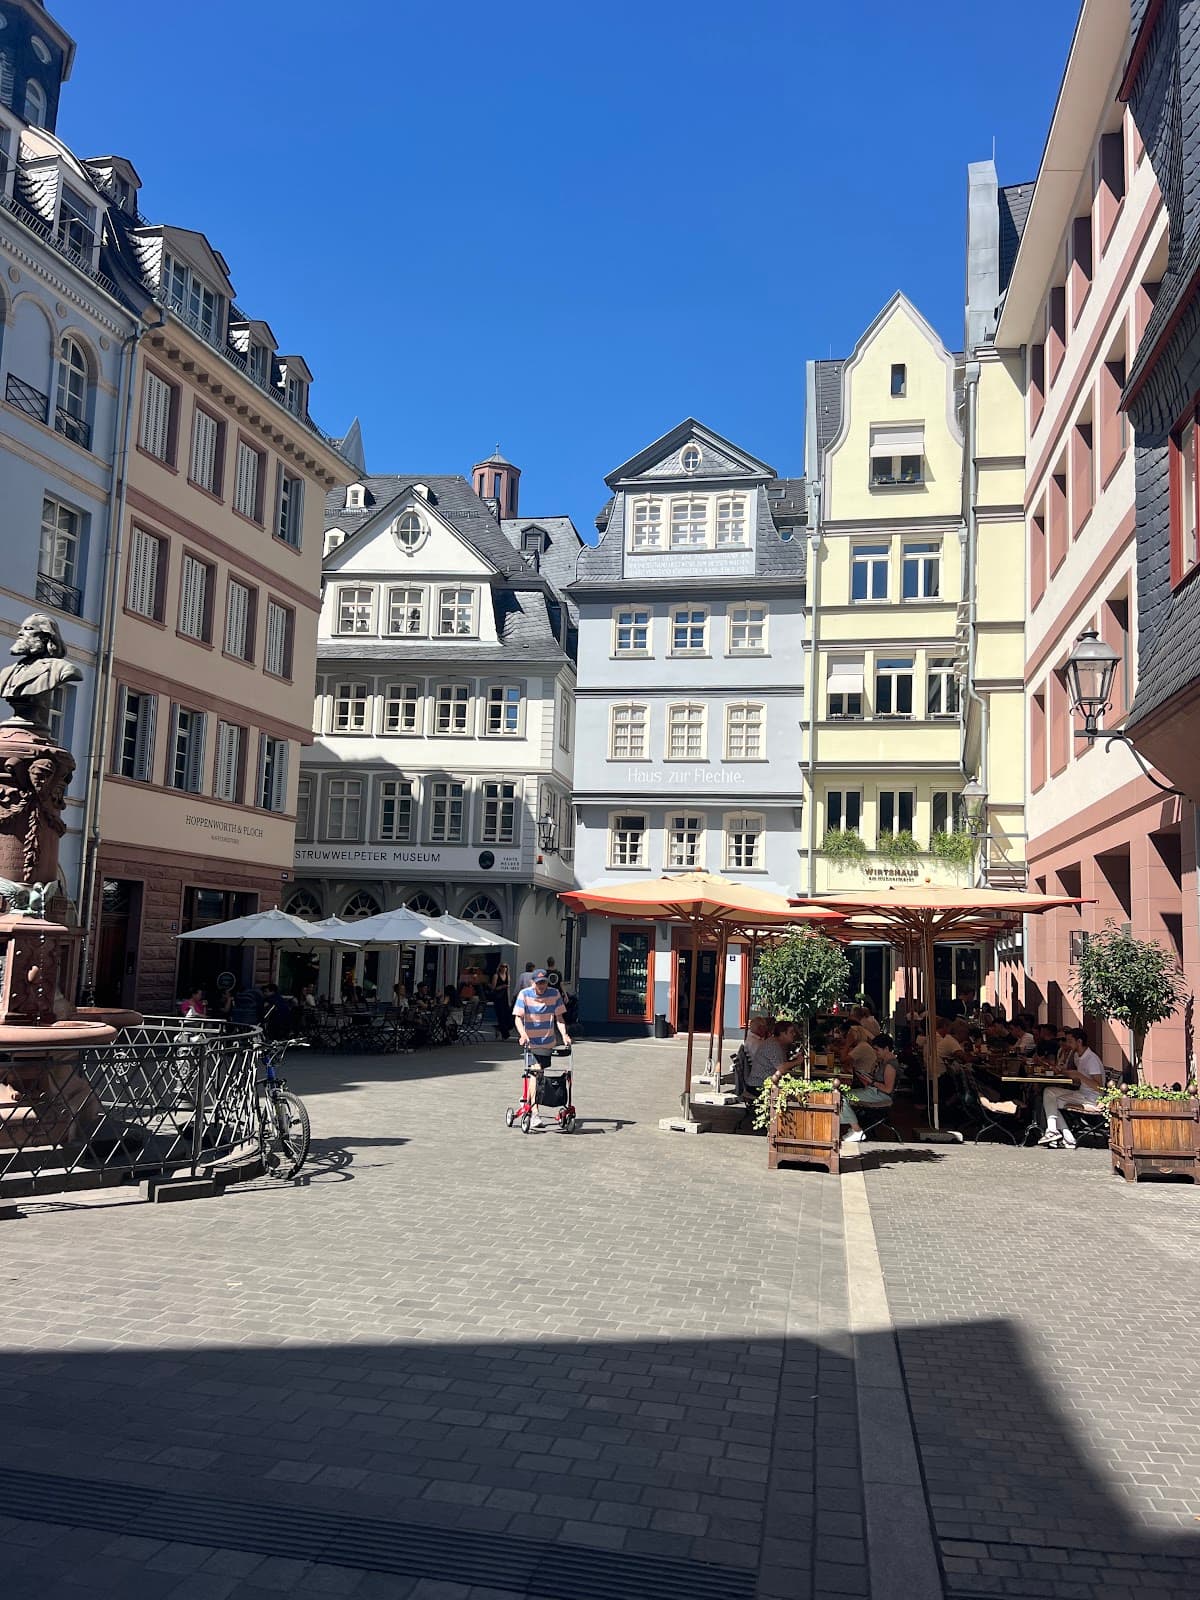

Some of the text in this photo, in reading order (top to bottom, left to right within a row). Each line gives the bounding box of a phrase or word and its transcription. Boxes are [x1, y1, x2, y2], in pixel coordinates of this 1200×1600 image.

[627, 767, 662, 784] Haus
[668, 770, 691, 784] zur
[185, 815, 236, 834] HOPPENWORTH
[237, 825, 242, 834] &
[294, 849, 441, 863] STRUWWELPETER MUSEUM
[865, 868, 919, 877] WIRTSHAUS
